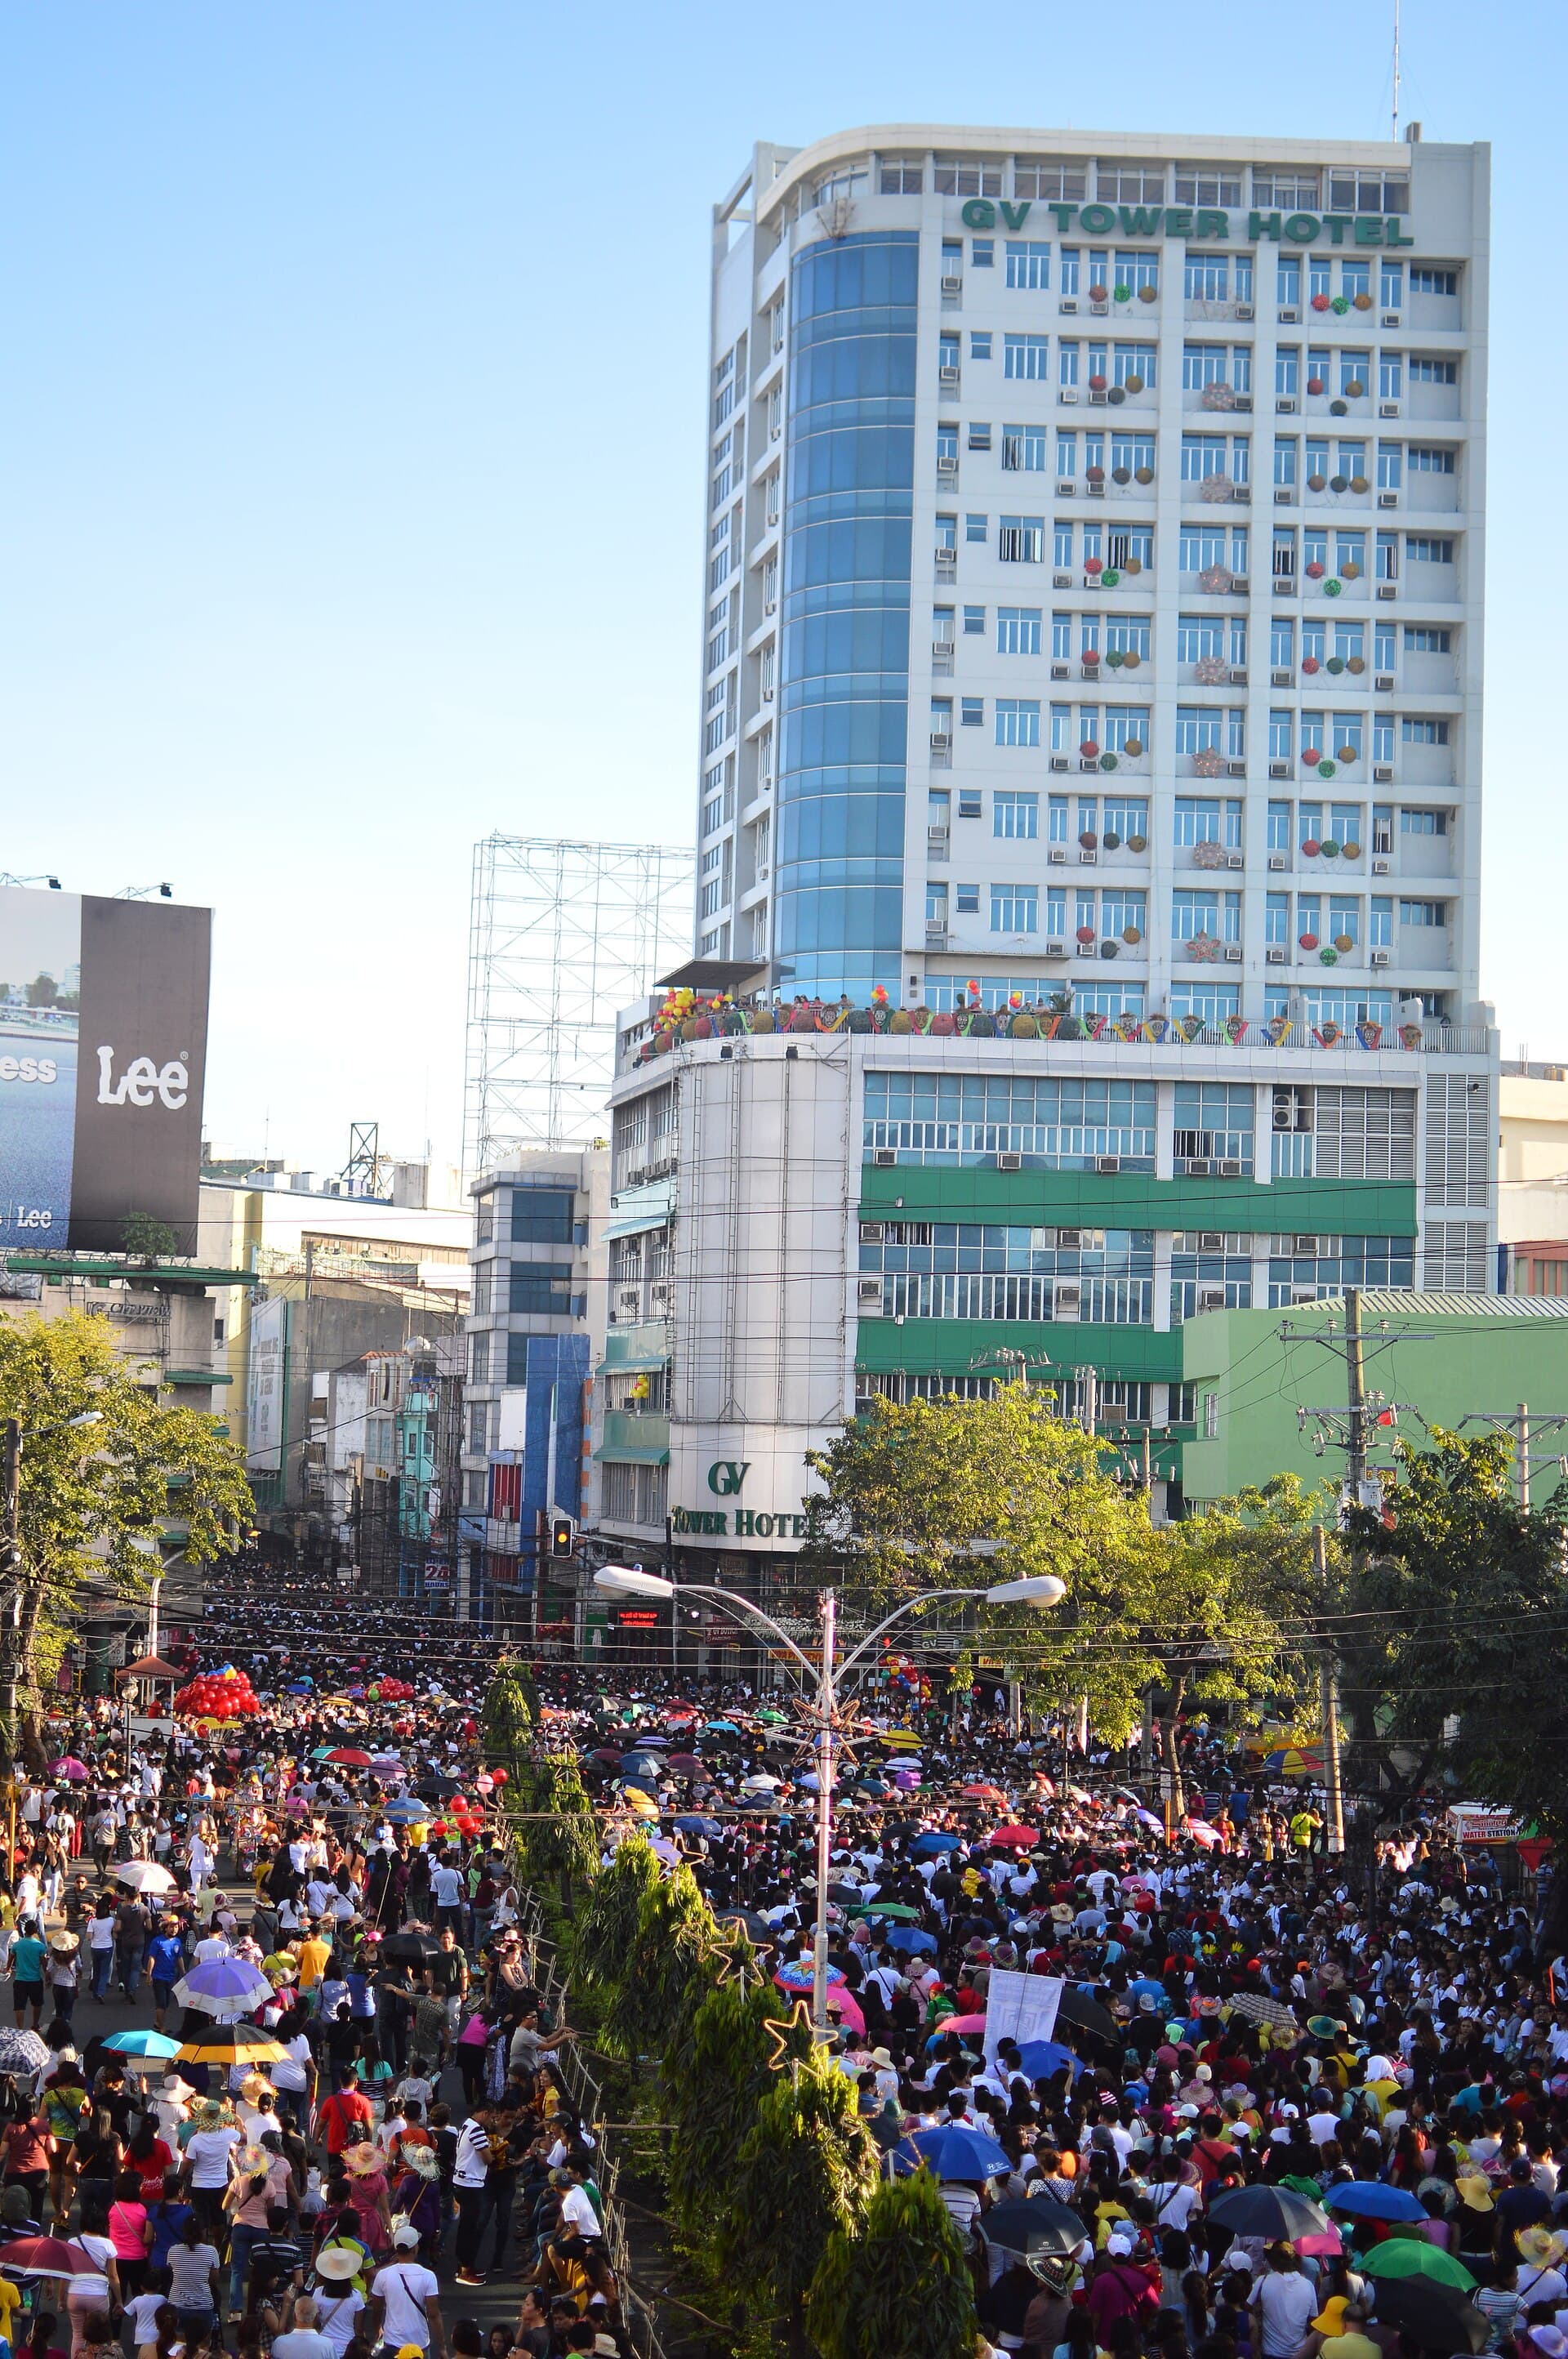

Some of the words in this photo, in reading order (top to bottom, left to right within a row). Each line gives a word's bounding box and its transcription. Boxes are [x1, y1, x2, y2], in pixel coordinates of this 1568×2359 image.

[961, 198, 1031, 231] GV
[1049, 203, 1230, 239] TOWER
[1248, 211, 1414, 247] HOTEL
[97, 1045, 189, 1109] Lee
[17, 1206, 52, 1229] Lee
[708, 1461, 751, 1496] GV
[671, 1505, 727, 1536] TOWER
[425, 1565, 448, 1581] 24
[1463, 1831, 1486, 1839] WATER
[1487, 1829, 1516, 1838] STATION
